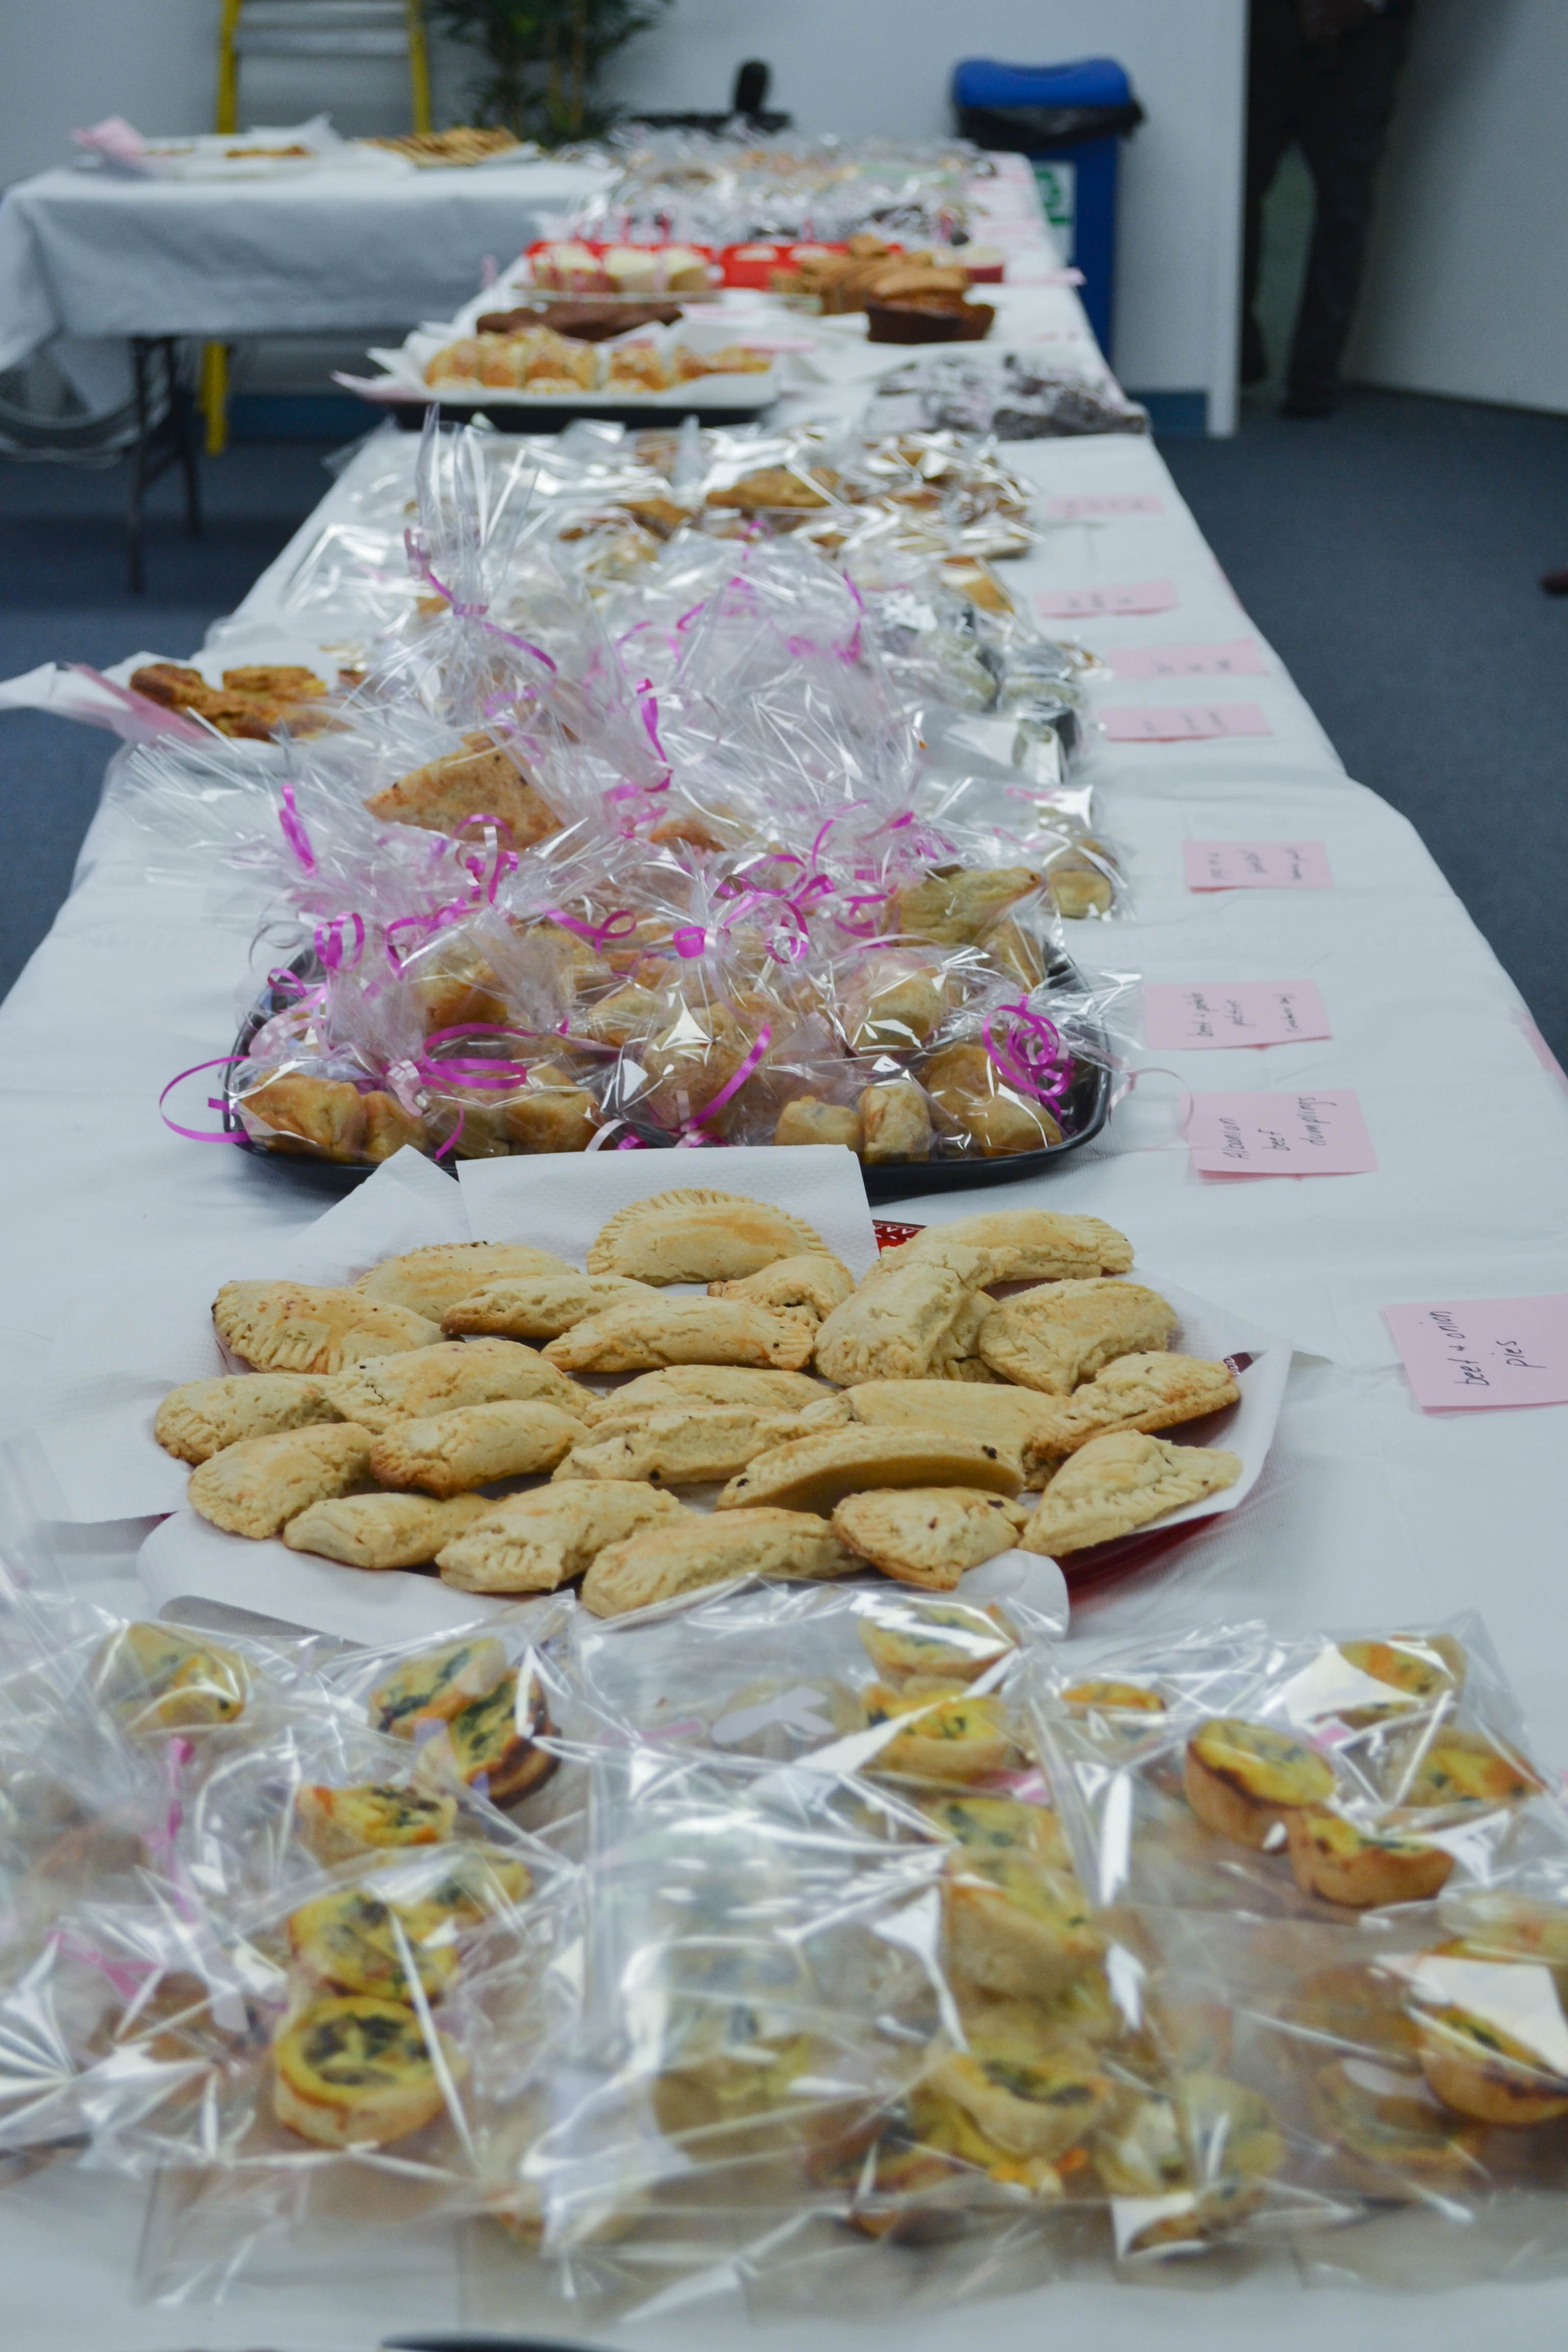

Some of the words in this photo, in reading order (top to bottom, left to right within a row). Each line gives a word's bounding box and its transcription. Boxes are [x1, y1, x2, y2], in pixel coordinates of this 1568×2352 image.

[1296, 1096, 1337, 1146] dumplings
[1257, 1128, 1291, 1151] beef
[1417, 1310, 1465, 1339] onion
[1490, 1340, 1548, 1369] pies
[1447, 1357, 1490, 1386] beef
